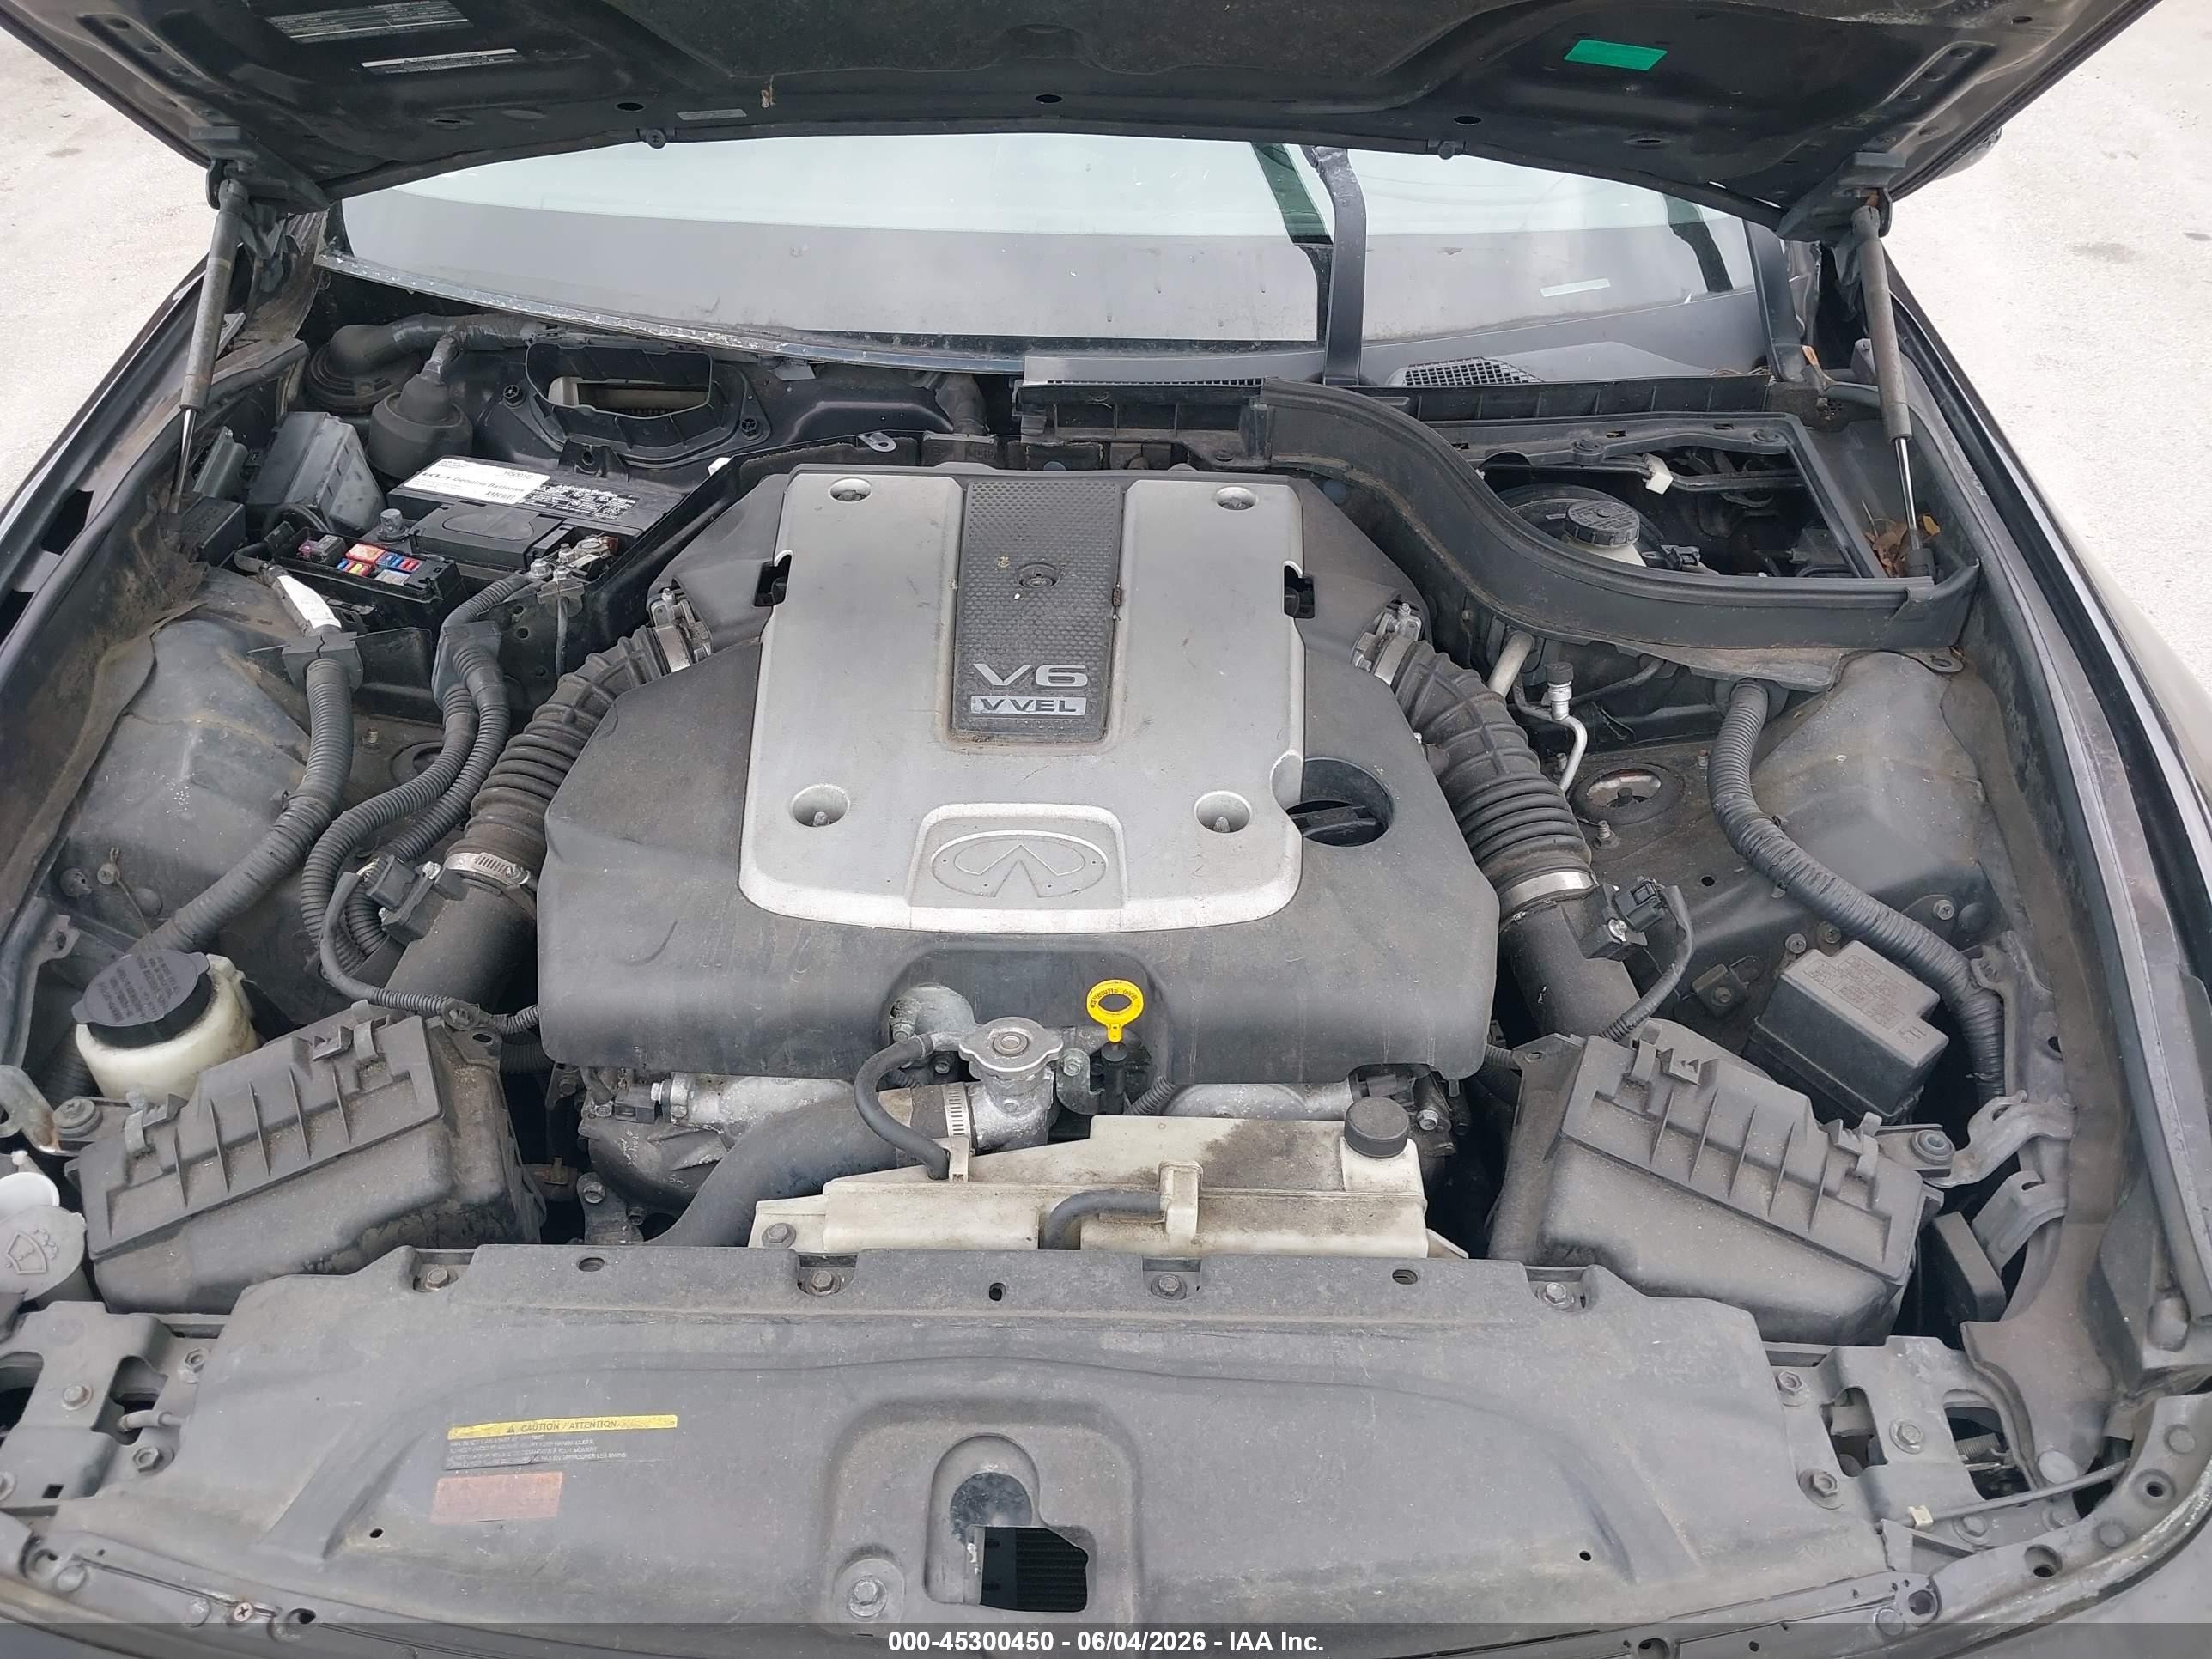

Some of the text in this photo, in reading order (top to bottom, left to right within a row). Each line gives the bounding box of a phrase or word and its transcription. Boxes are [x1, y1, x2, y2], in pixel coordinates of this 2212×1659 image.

[453, 477, 487, 486] Genuine
[488, 483, 525, 492] Batteries
[972, 663, 1088, 688] V6
[981, 698, 1077, 713] VVEL
[520, 1421, 560, 1431] CAUTION
[568, 1419, 617, 1430] ATTENTION
